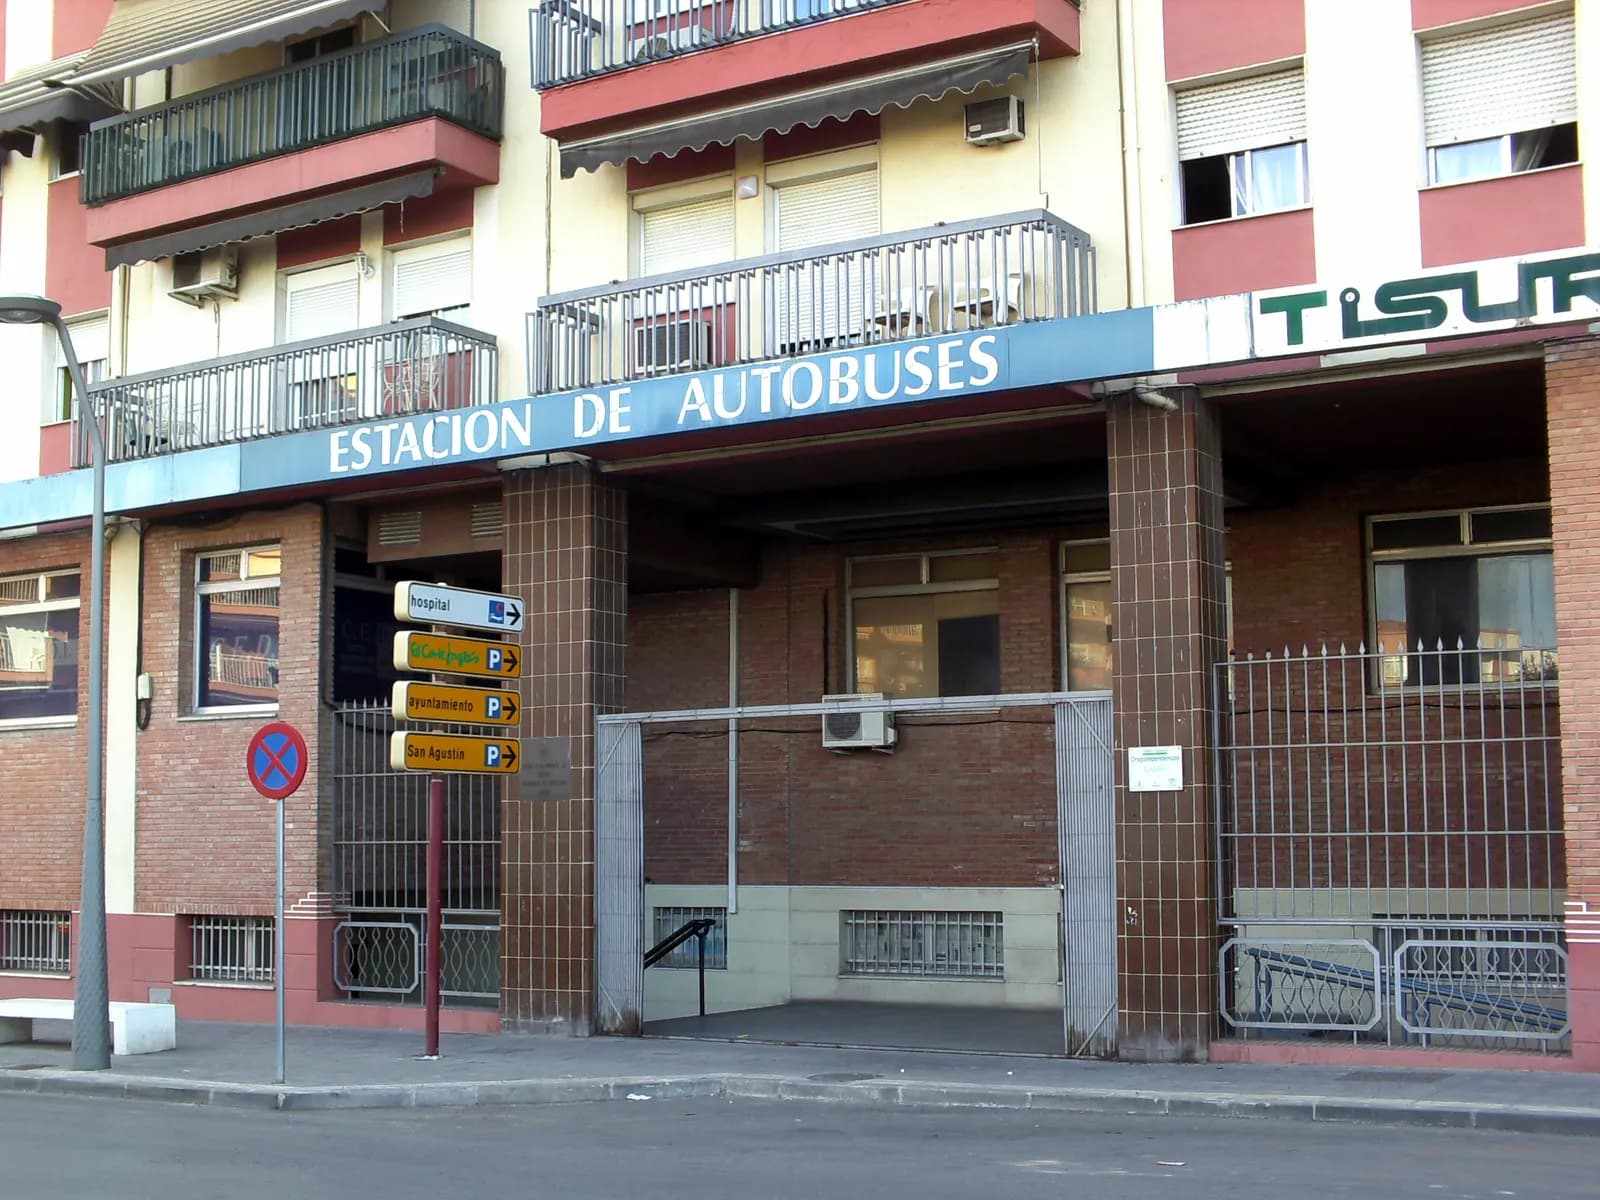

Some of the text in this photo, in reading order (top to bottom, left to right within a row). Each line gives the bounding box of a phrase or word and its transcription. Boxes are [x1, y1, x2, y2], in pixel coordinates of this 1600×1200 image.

[329, 335, 999, 473] ESTACION DE AUTOBUSES
[411, 594, 450, 611] hospital
[409, 696, 474, 712] ayuntamiento
[407, 744, 426, 758] San
